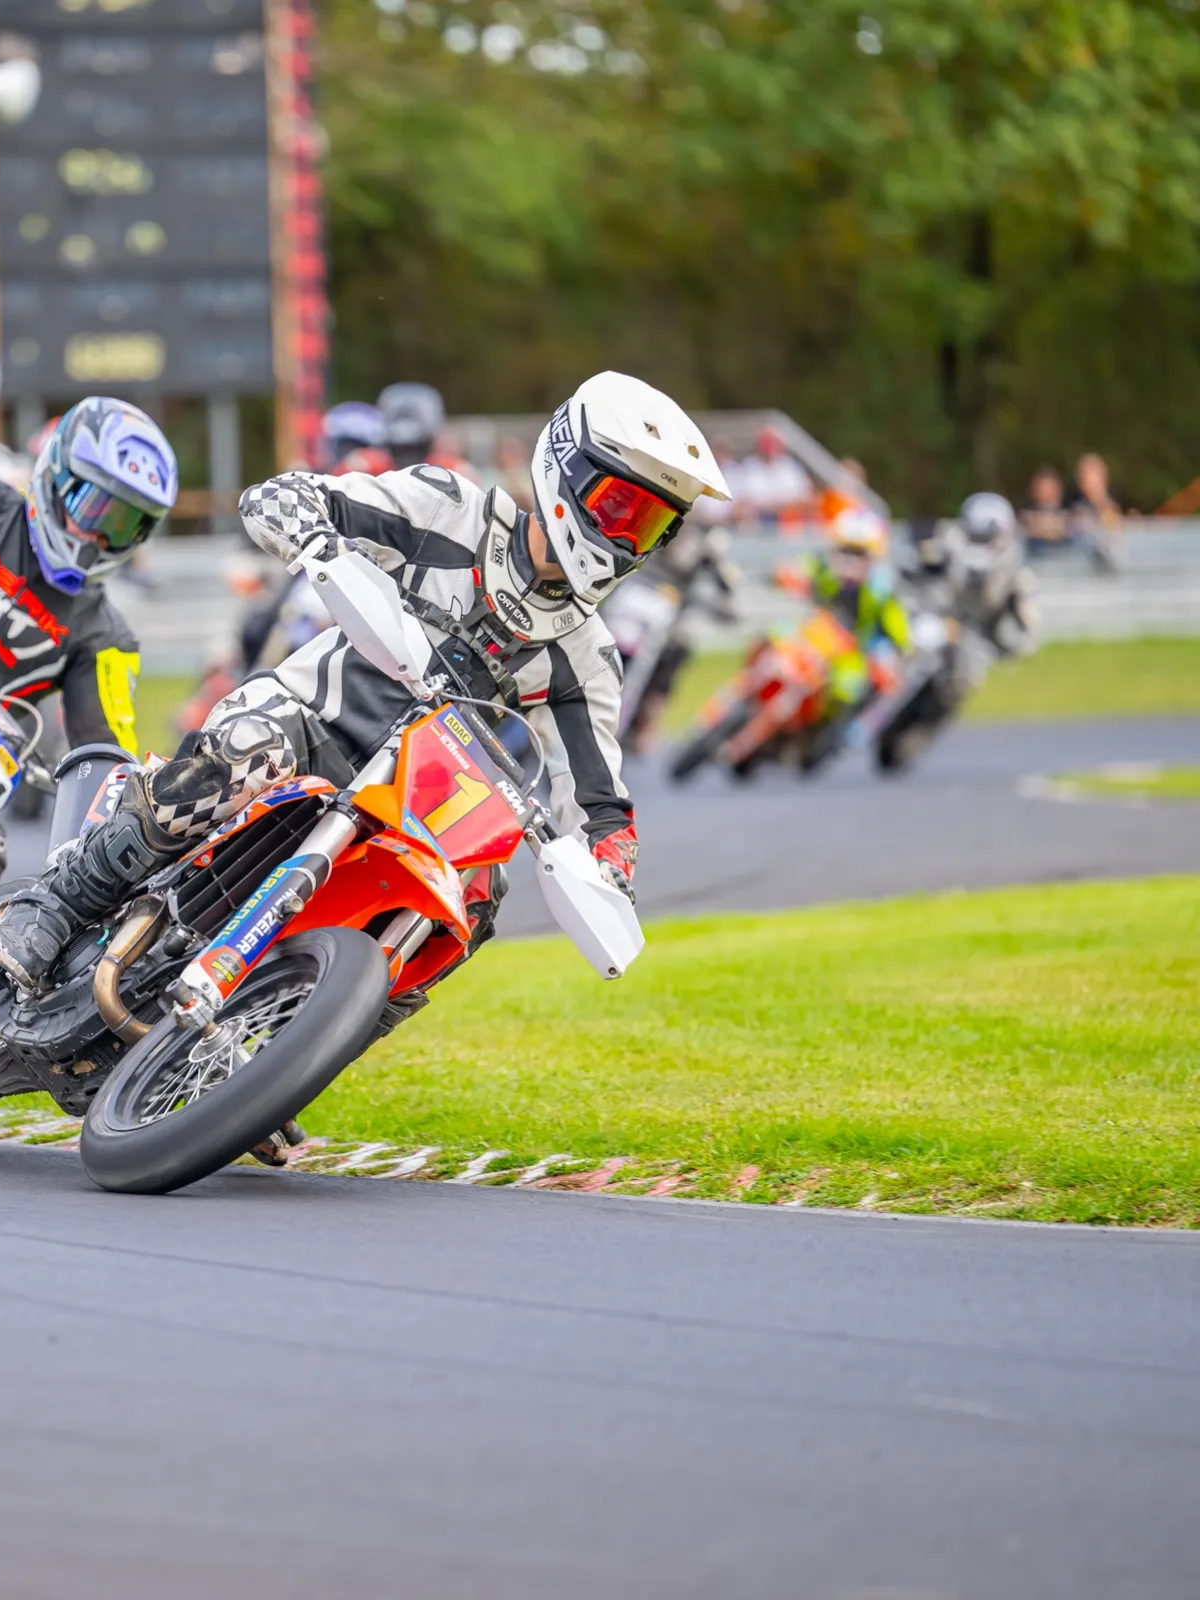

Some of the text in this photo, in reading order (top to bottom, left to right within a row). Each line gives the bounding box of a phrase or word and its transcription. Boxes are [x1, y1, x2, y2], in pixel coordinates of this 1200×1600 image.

[497, 592, 532, 630] ORTEMA
[446, 715, 473, 746] ADAC
[422, 770, 493, 838] 1
[496, 780, 527, 815] KTM
[221, 866, 288, 937] RAVENOL
